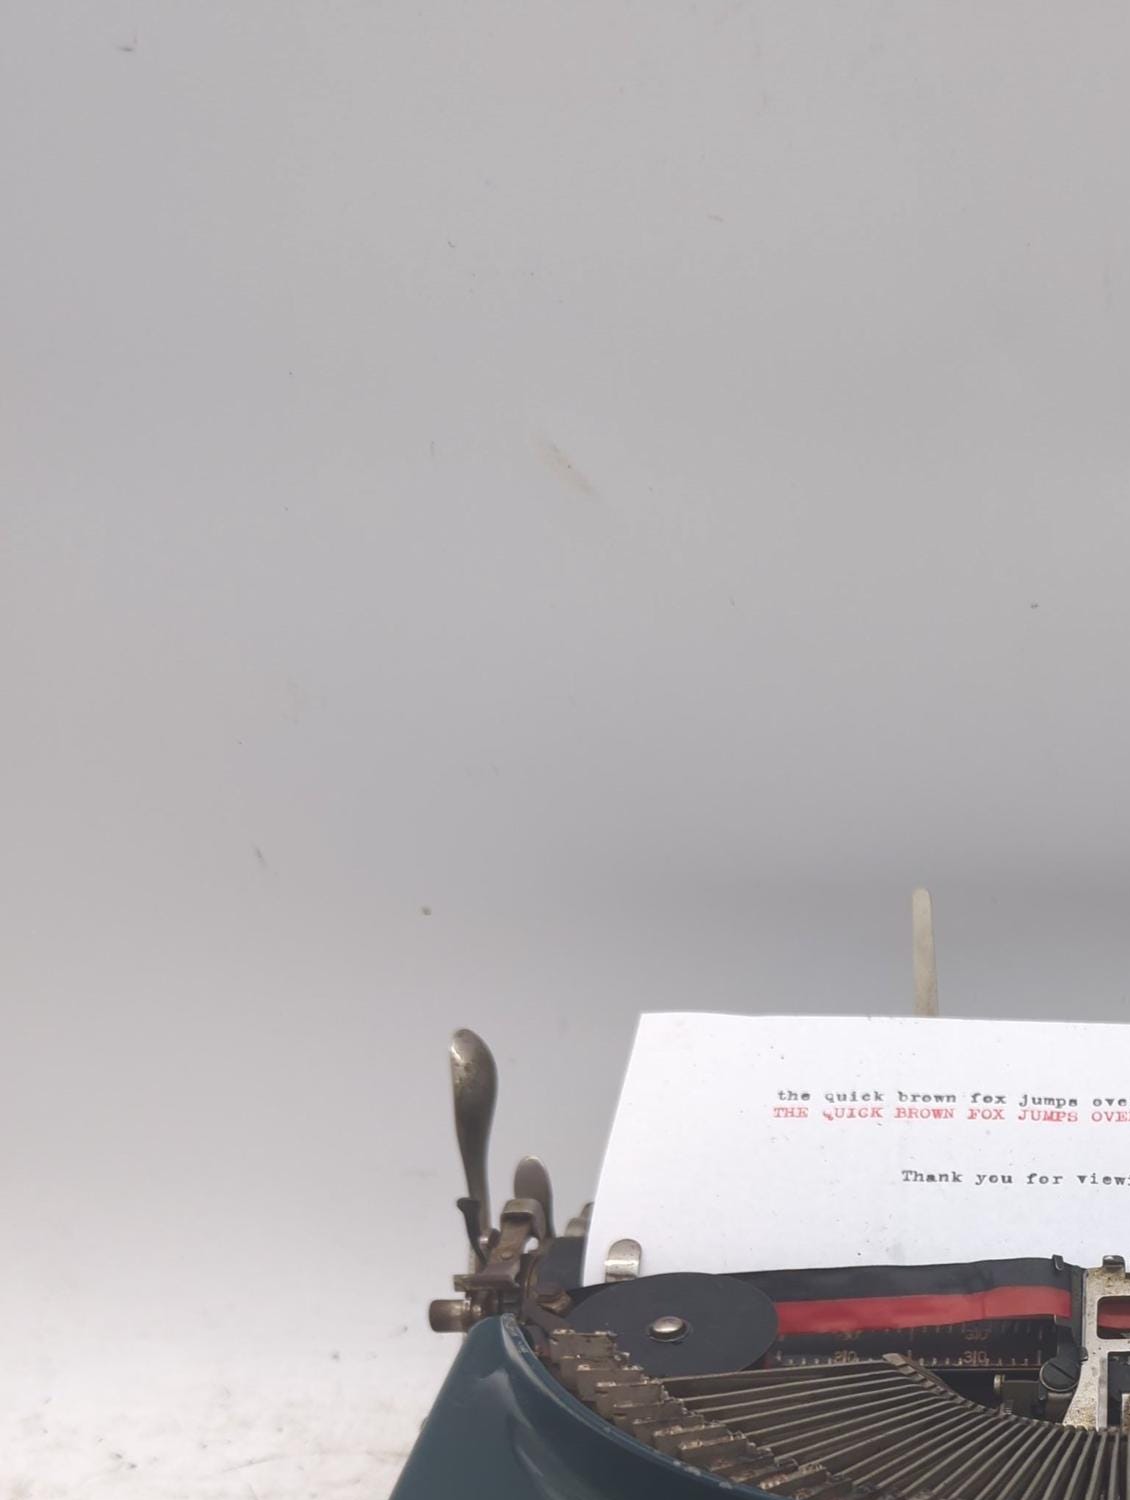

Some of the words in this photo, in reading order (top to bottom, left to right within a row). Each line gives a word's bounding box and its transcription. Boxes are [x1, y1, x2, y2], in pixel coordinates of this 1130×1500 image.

[776, 1090, 811, 1102] the
[825, 1090, 884, 1104] quick
[898, 1091, 957, 1104] brown
[970, 1092, 1007, 1105] fox
[1019, 1093, 1078, 1108] jumps
[773, 1107, 809, 1119] THE
[894, 1107, 955, 1120] BROWN
[967, 1108, 1005, 1120] FOX
[1018, 1108, 1078, 1123] JUMPS
[901, 1170, 963, 1184] Thank
[975, 1173, 1013, 1187] you
[1026, 1171, 1064, 1185] for
